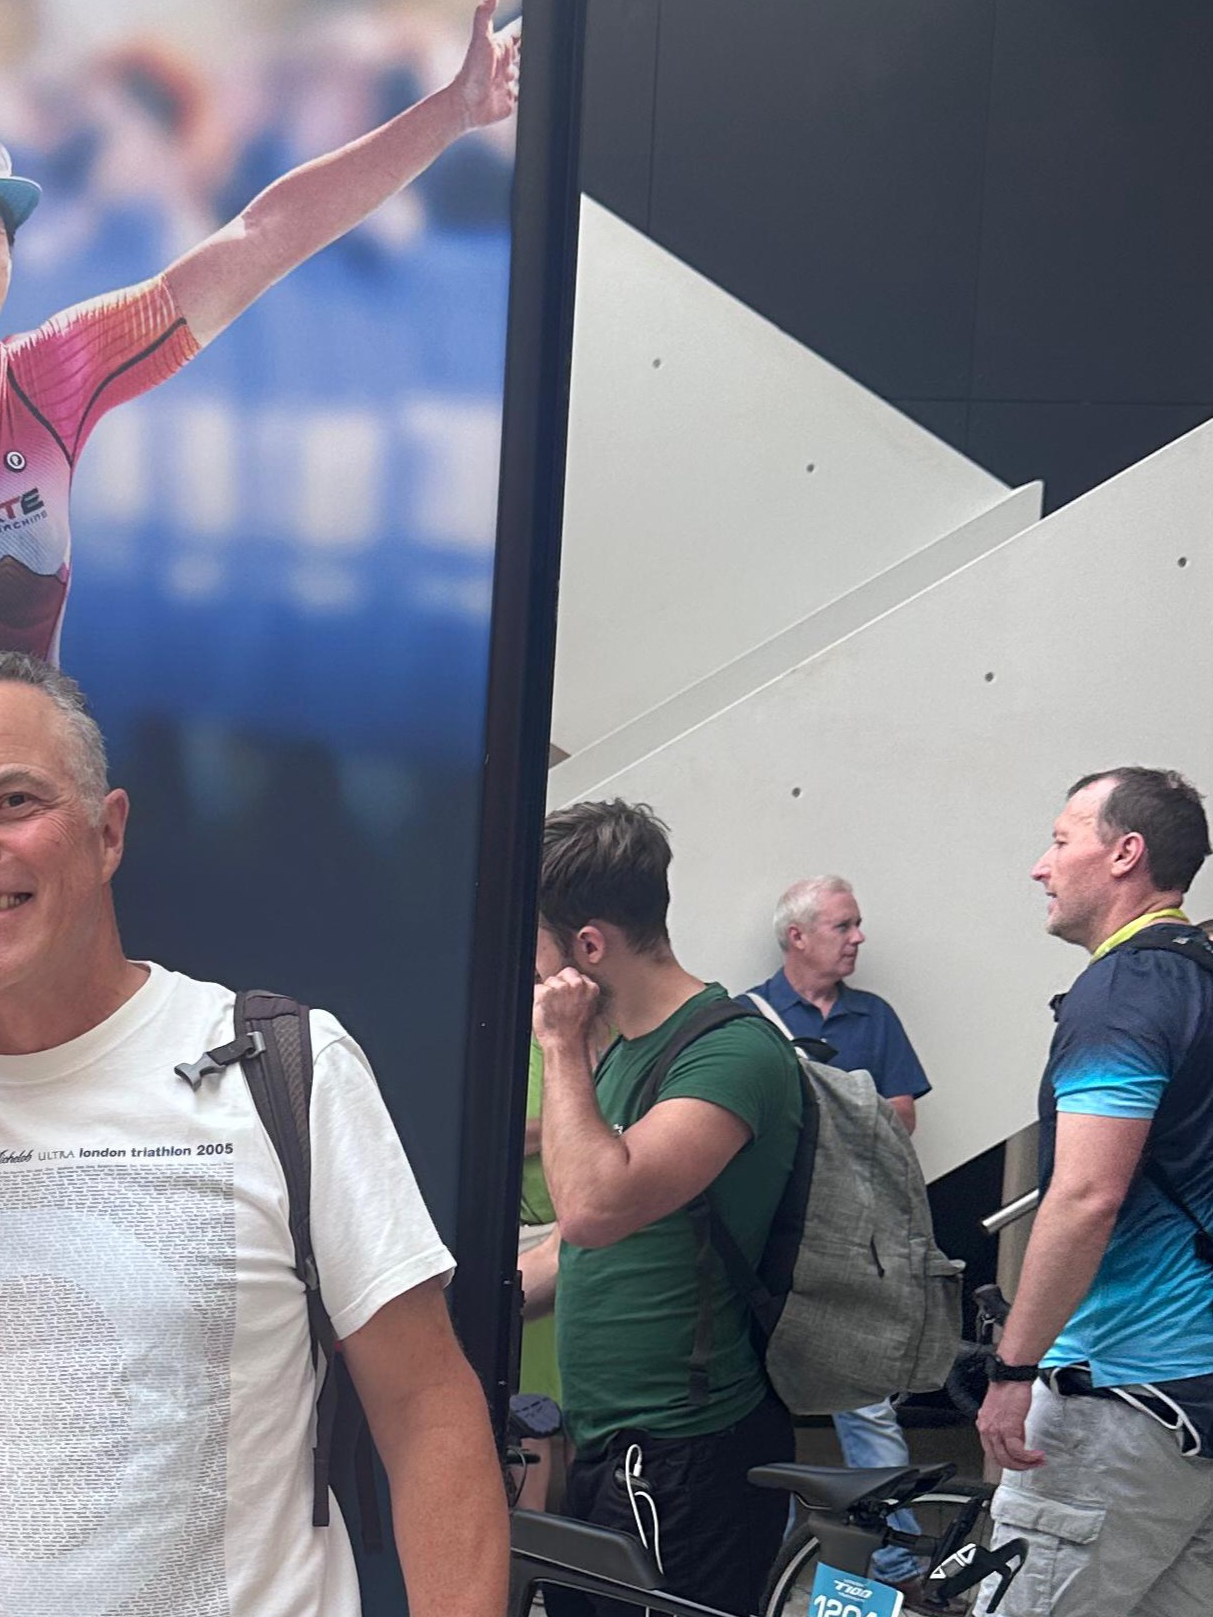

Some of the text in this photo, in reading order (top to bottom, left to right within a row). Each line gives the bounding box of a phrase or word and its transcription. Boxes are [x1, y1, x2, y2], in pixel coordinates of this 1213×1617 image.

[38, 1150, 75, 1162] ULTRA
[79, 1147, 126, 1158] london
[131, 1145, 192, 1158] triathlon
[196, 1143, 234, 1156] 2005
[833, 1579, 874, 1599] T100
